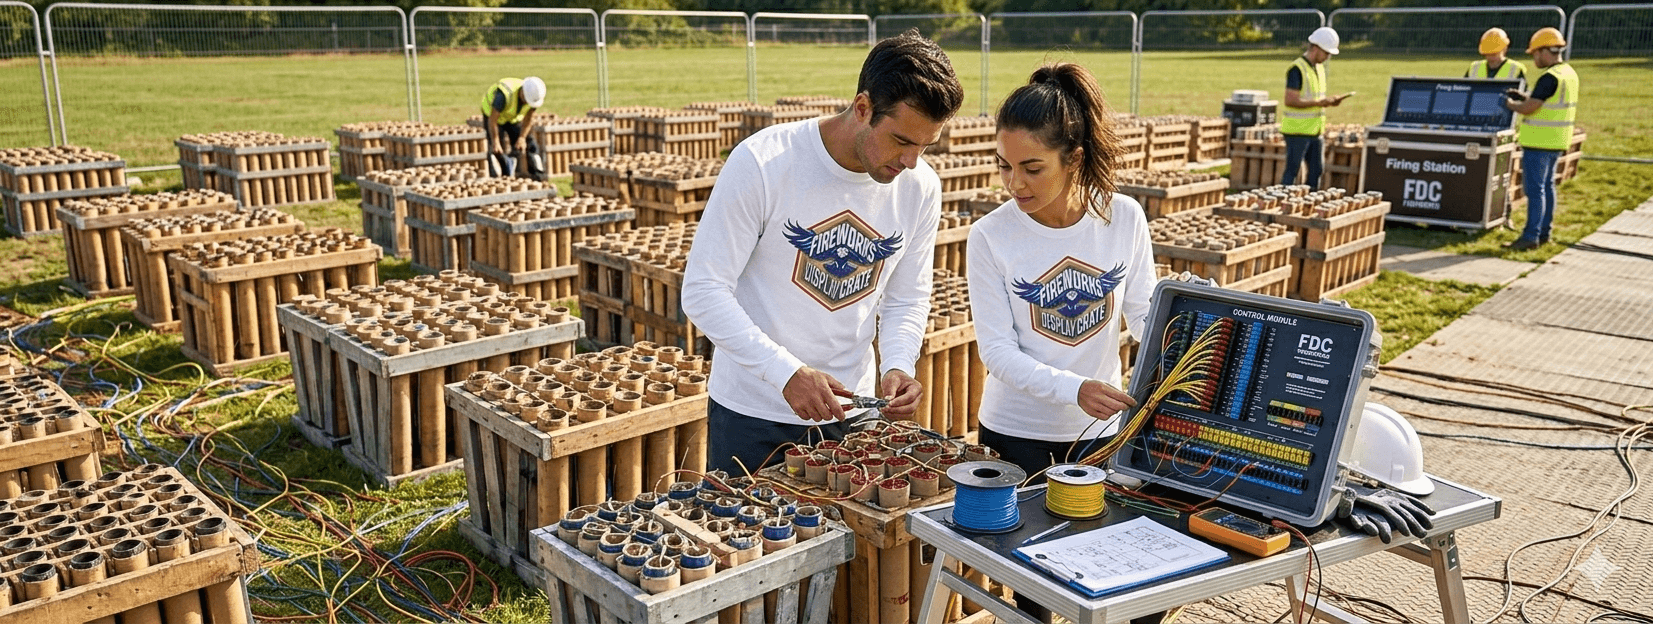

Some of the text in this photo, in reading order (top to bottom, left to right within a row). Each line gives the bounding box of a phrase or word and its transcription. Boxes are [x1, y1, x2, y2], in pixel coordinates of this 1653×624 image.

[1385, 157, 1466, 174] Firing Station
[1403, 178, 1442, 202] FDC
[809, 222, 877, 263] FIREWORKS
[839, 267, 874, 299] CRATE
[1040, 268, 1104, 308] FIREWORKS
[1077, 302, 1106, 335] CRATE
[1233, 308, 1298, 326] CONTROL MODULE
[1298, 333, 1333, 353] FDC
